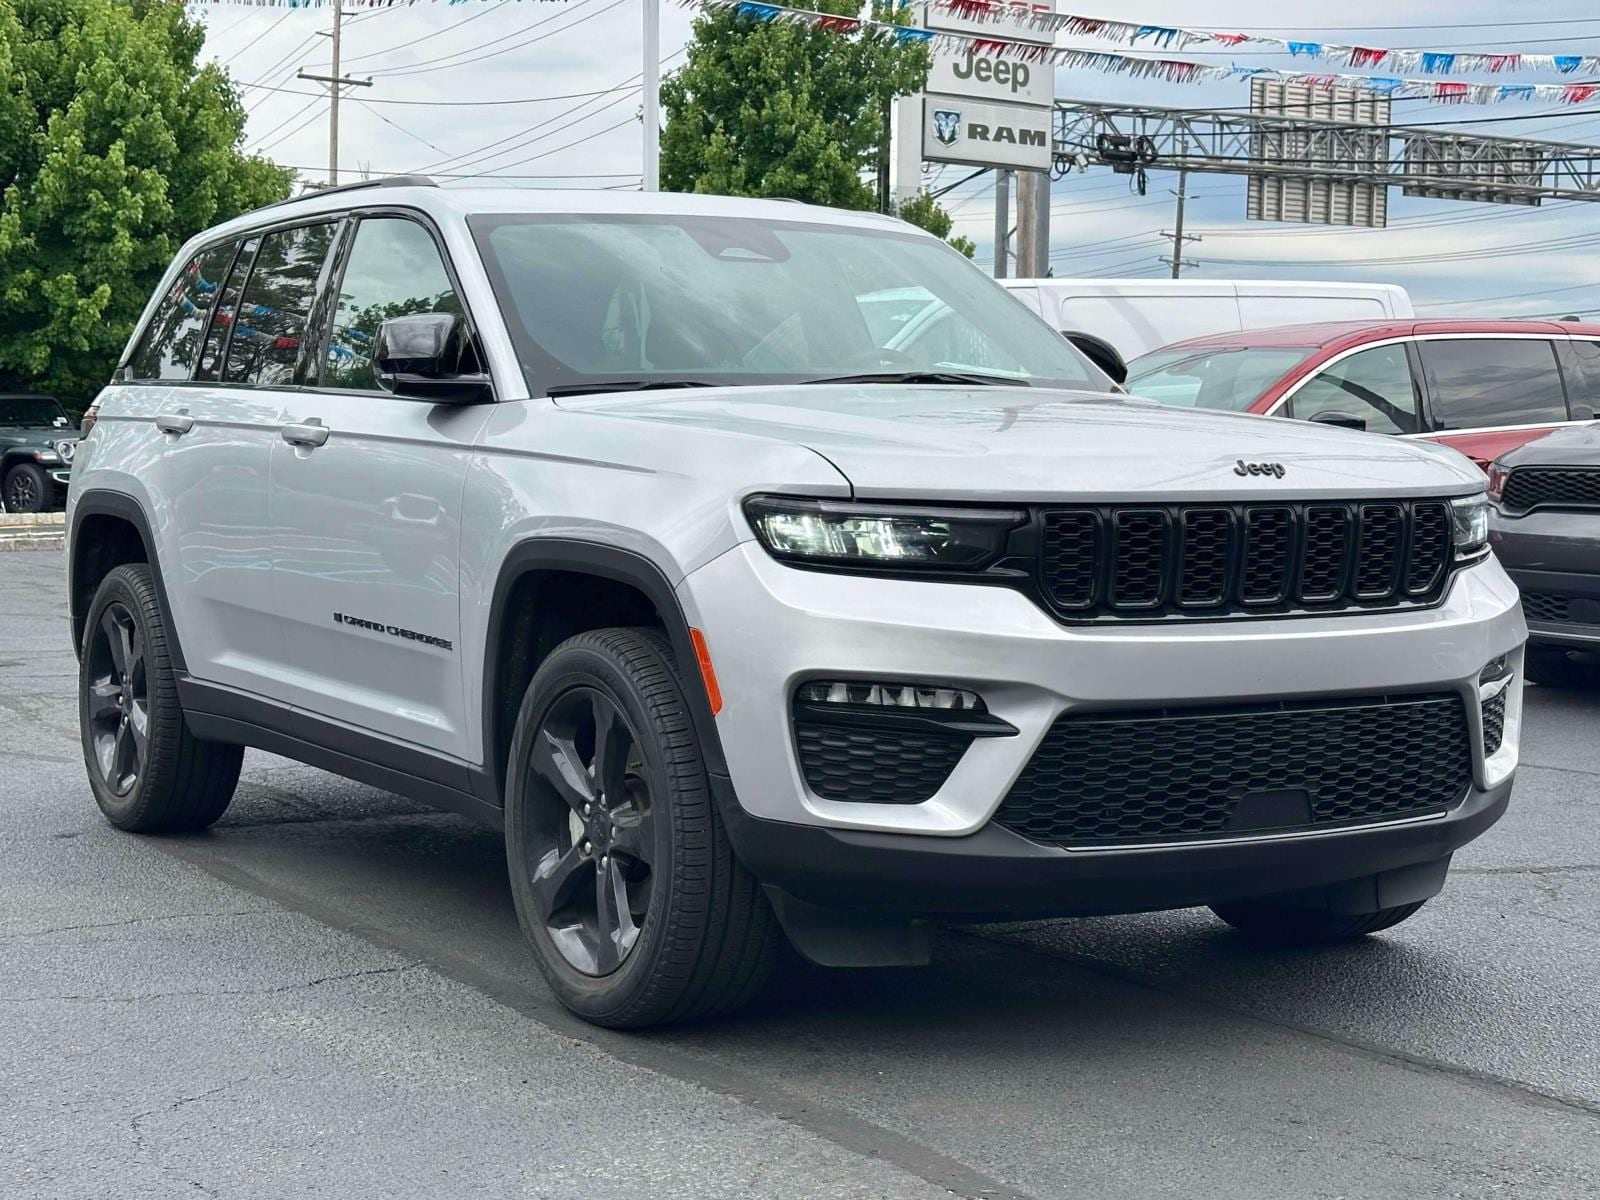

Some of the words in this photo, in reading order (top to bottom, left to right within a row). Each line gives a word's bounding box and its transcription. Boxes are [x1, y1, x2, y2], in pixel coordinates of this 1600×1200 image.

[953, 53, 1030, 93] Jeep
[967, 123, 1046, 147] RAM
[1233, 459, 1286, 479] Jeep
[343, 615, 385, 633] GRAND
[386, 625, 453, 651] CHEROKEE
